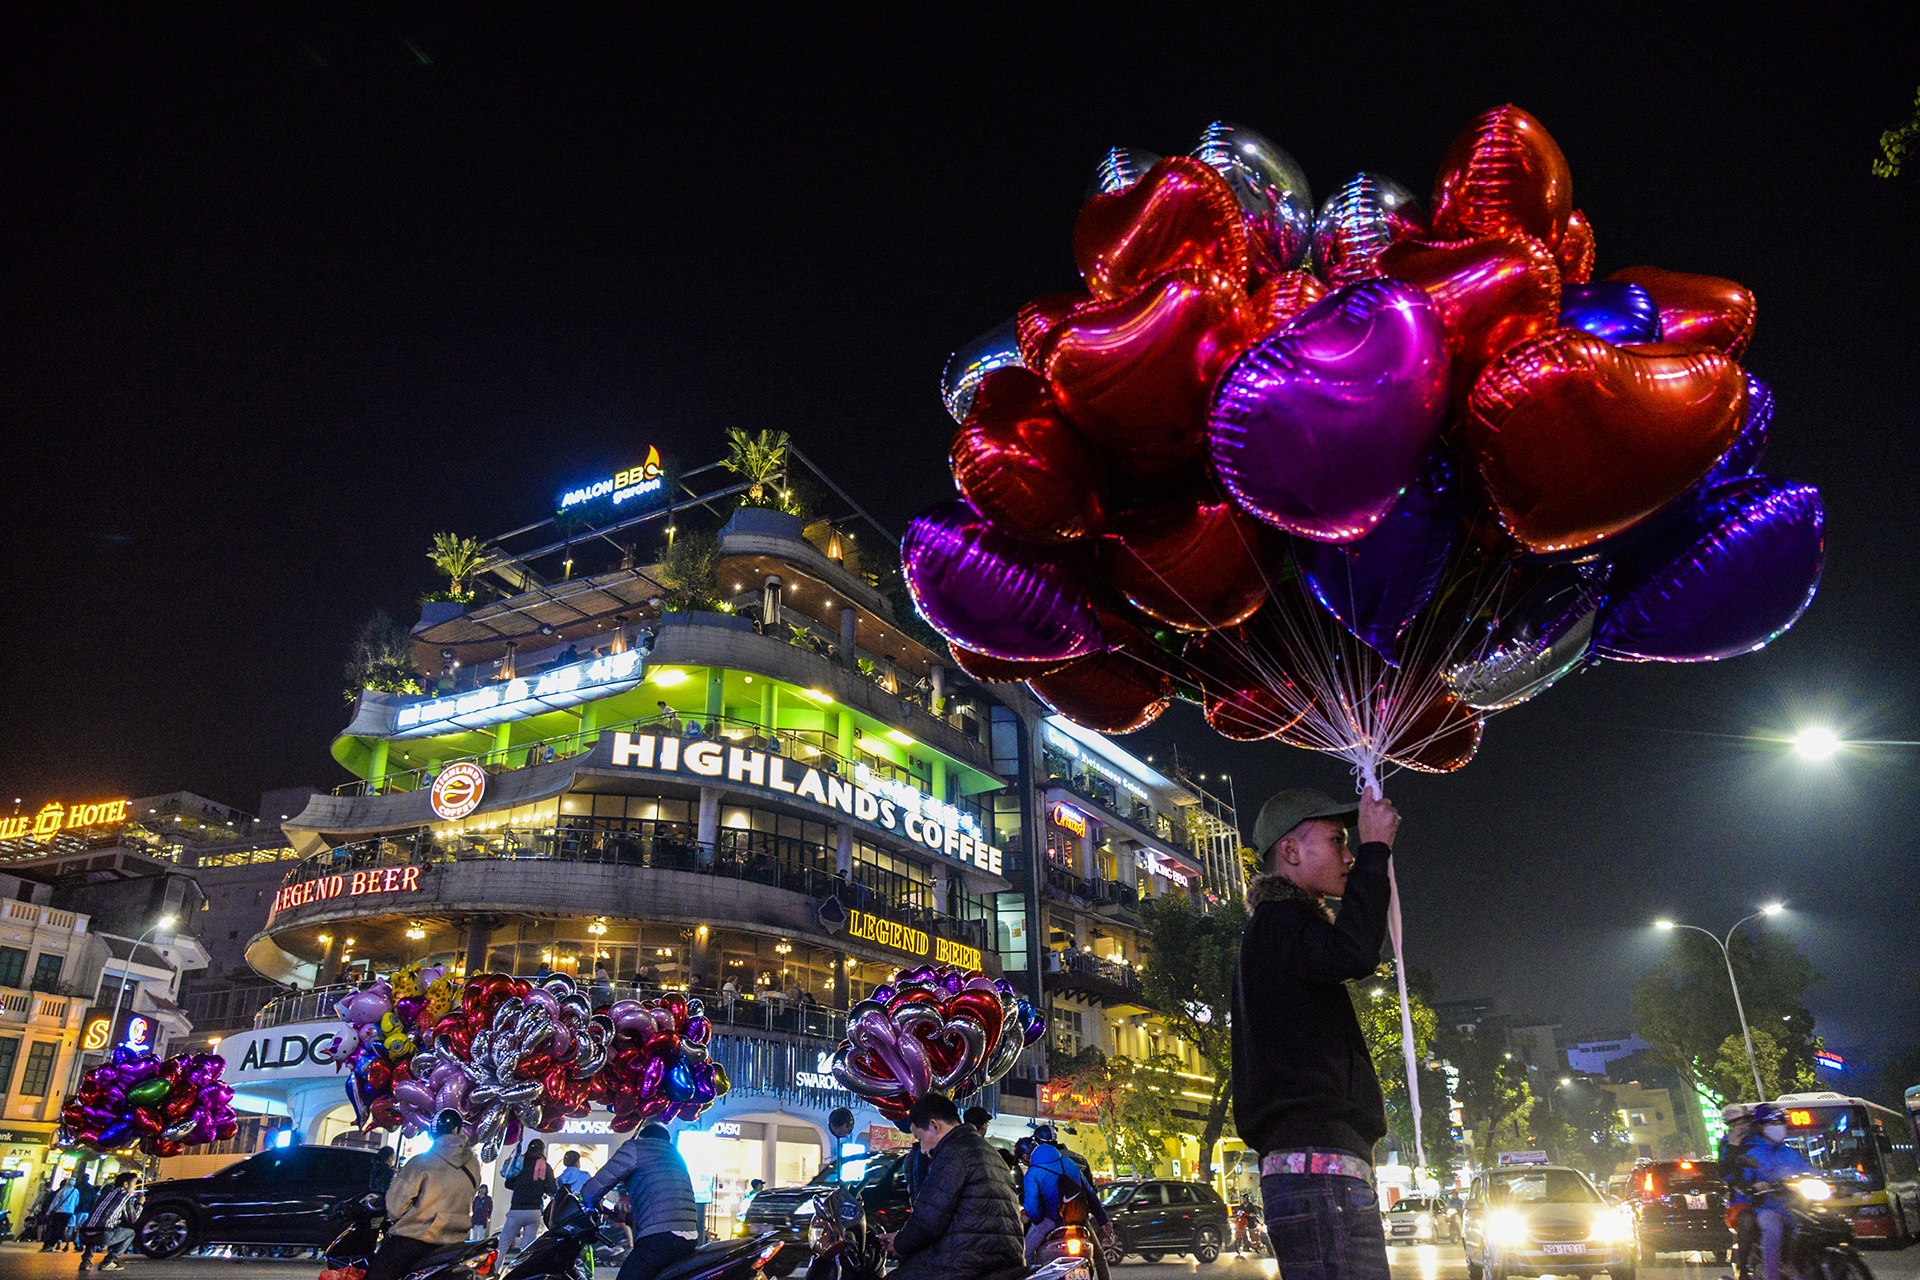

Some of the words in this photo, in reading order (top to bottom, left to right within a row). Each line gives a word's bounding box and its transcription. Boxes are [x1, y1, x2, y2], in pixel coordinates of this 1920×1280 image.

[561, 479, 613, 507] AVALON
[612, 478, 661, 504] garden
[434, 766, 482, 793] HIGHLANDS
[66, 800, 127, 828] HOTEL
[438, 799, 475, 817] COFFEE
[611, 731, 896, 829] HIGHLANDS
[904, 811, 1002, 876] COFFEE
[275, 874, 345, 912] LEGEND
[350, 866, 421, 896] BEER
[849, 909, 930, 956] LEGEND
[935, 937, 983, 972] BEER
[796, 1071, 847, 1091] SWAROV
[558, 1120, 615, 1134] AROVSK
[1790, 1111, 1812, 1126] 09
[11, 1148, 32, 1156] ATM
